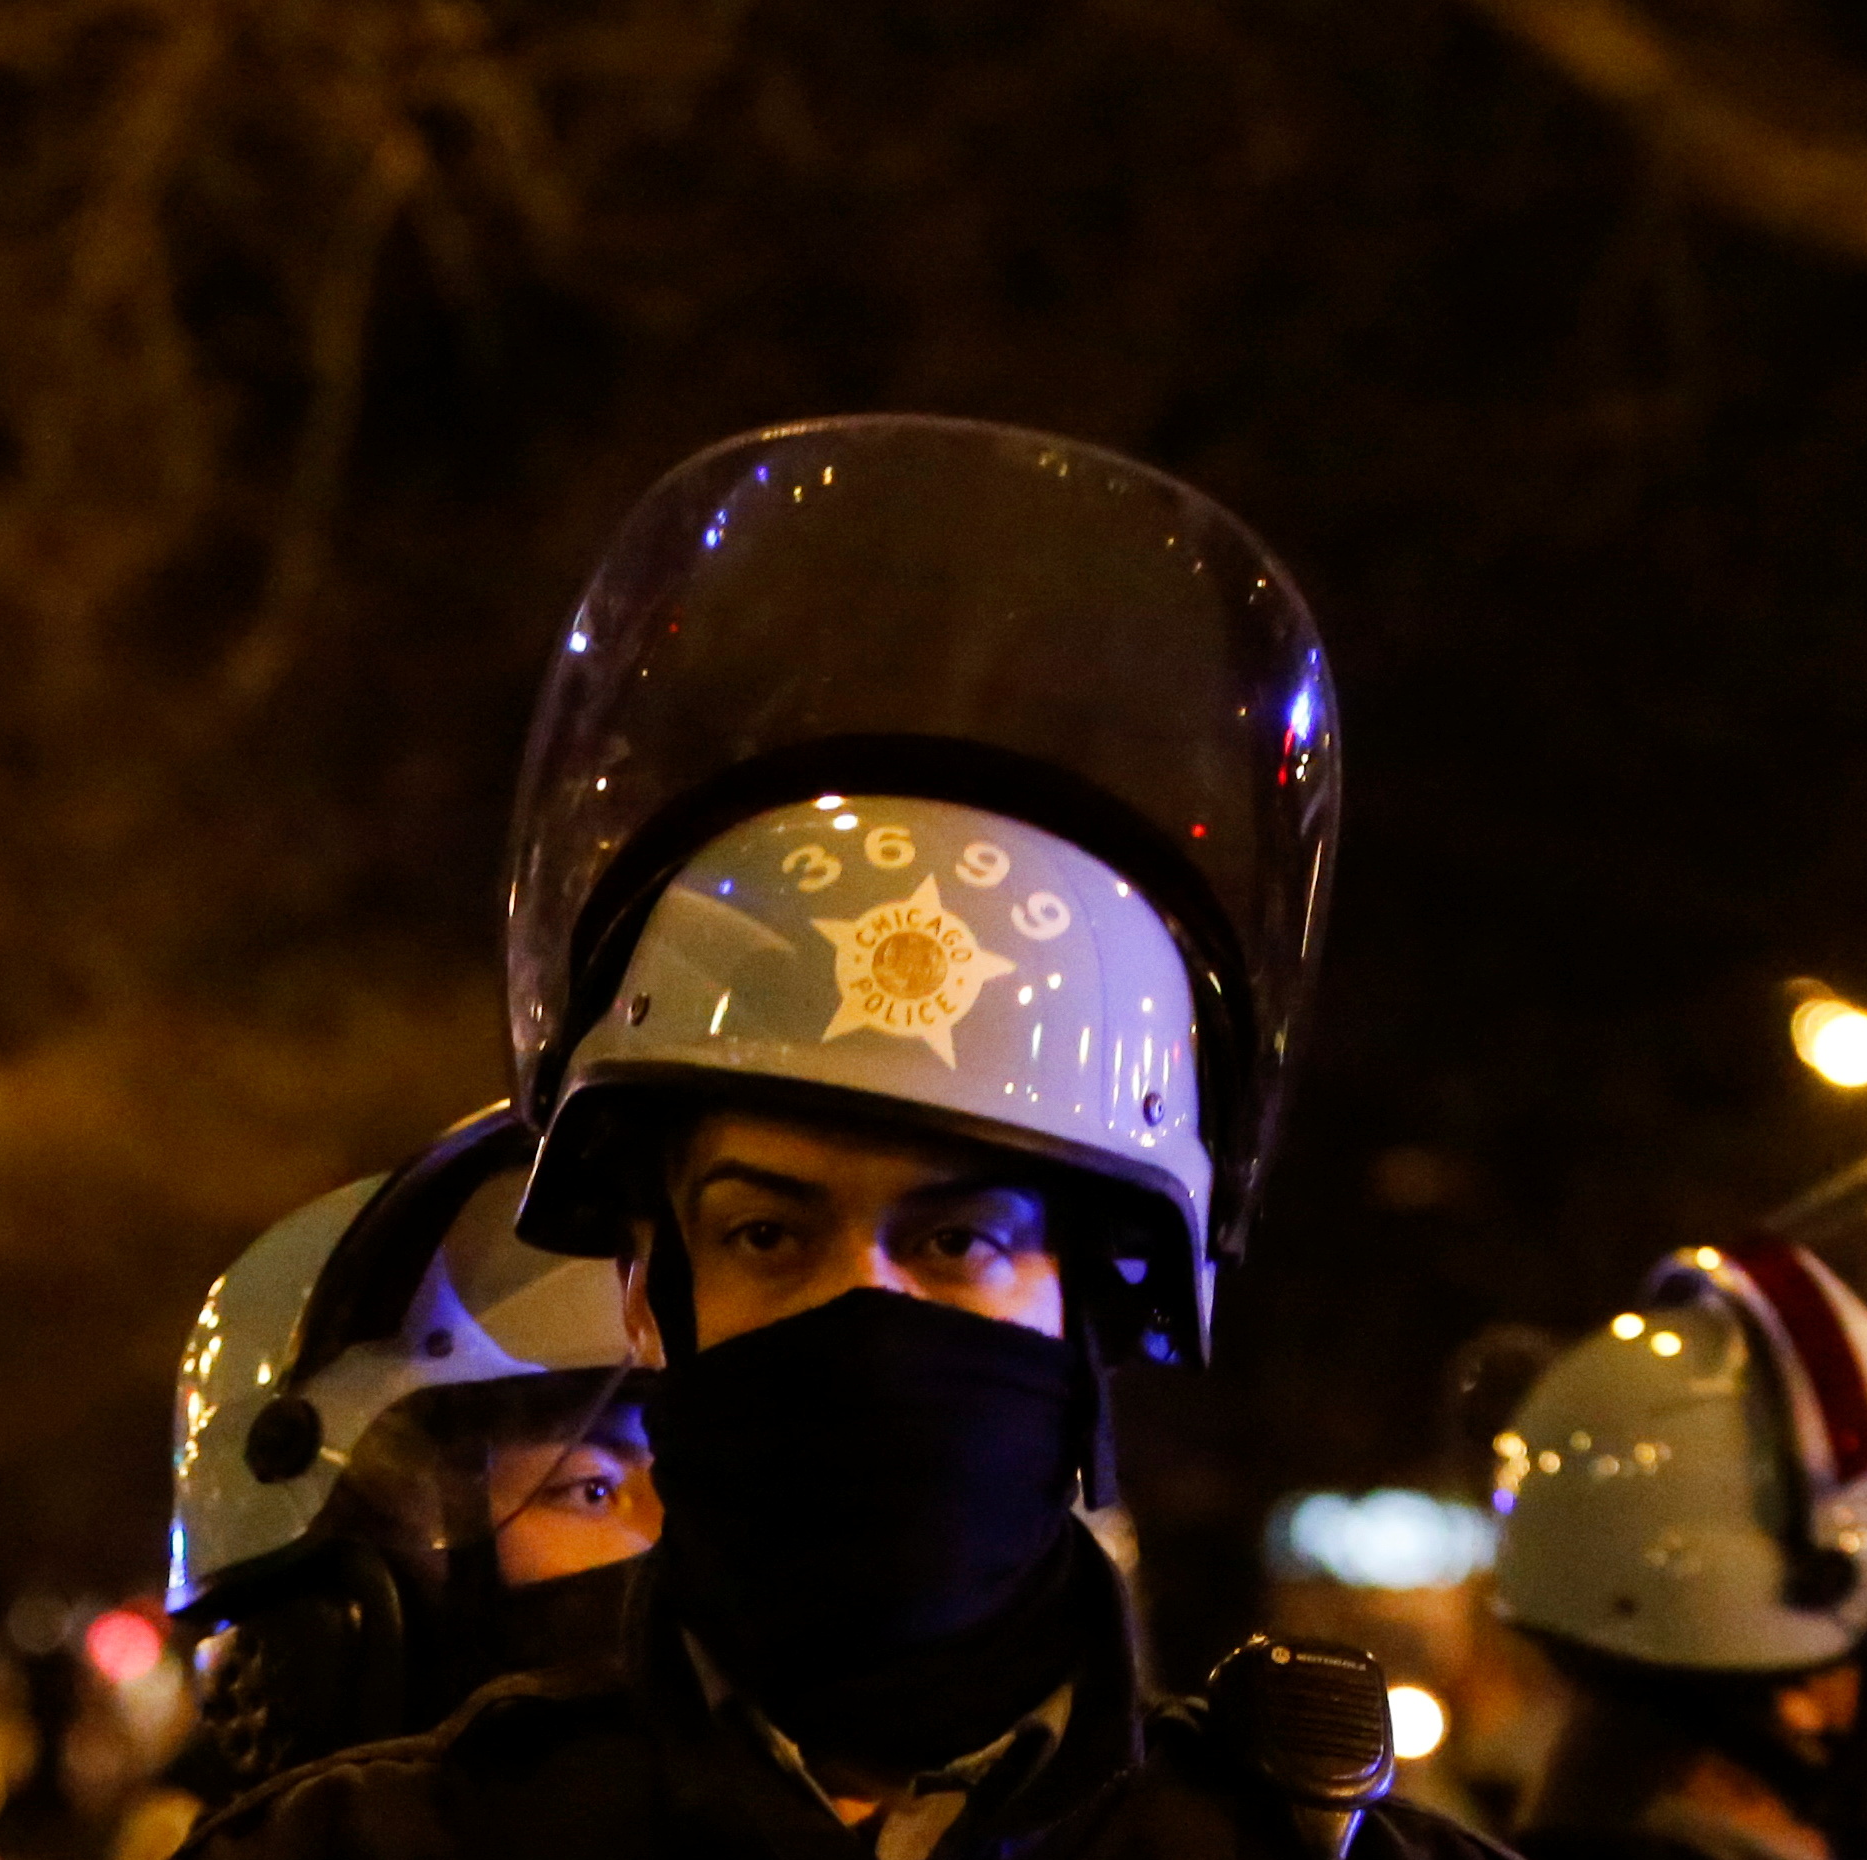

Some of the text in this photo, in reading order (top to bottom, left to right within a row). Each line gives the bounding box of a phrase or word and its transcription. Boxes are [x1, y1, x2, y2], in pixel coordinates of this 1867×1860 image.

[782, 825, 1071, 941] 3699
[855, 907, 973, 963] CHICAGO
[849, 976, 958, 1026] POLICE
